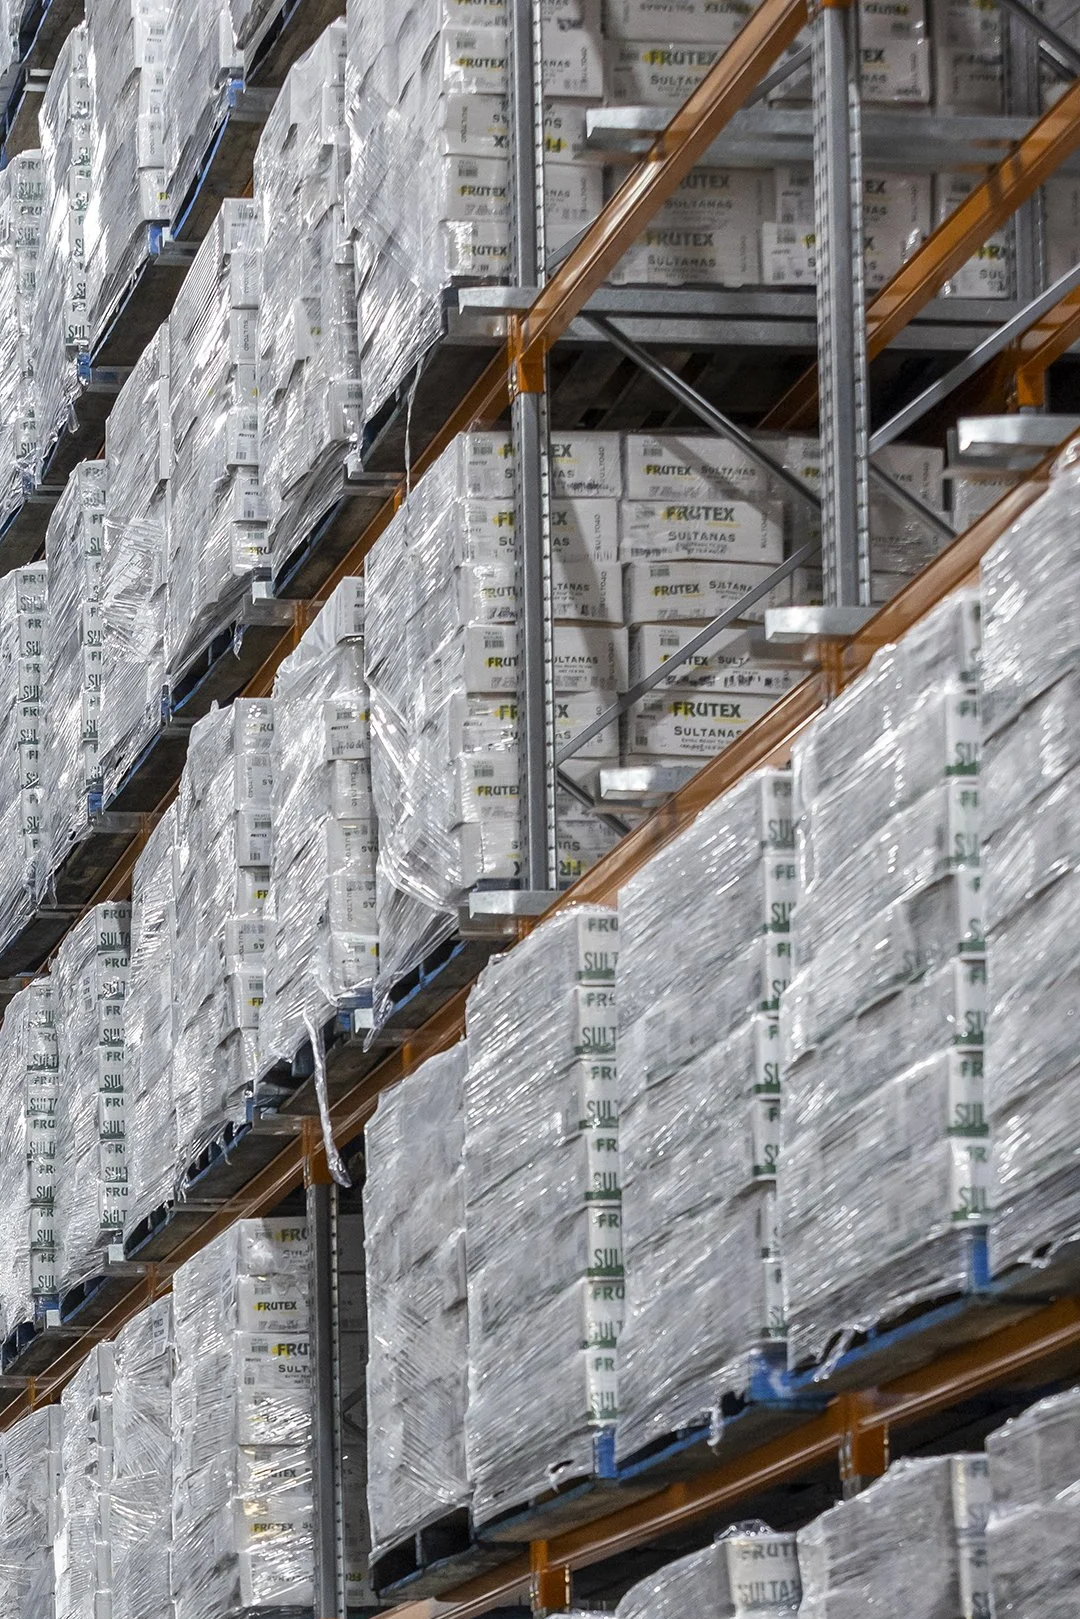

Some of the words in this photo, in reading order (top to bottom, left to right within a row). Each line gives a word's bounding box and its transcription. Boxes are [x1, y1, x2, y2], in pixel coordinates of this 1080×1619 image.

[458, 57, 505, 70] FRUTEX
[19, 182, 42, 195] SULT
[460, 185, 507, 199] FRUTEX
[20, 206, 42, 216] FRU
[646, 231, 714, 247] FRUTEX
[647, 255, 717, 268] SULTANAS
[68, 325, 91, 338] SULT
[645, 464, 693, 476] FRUTEX
[664, 505, 736, 522] FRUTEX
[668, 531, 736, 543] SULTANAS
[653, 583, 700, 597] FRUTEX
[488, 656, 517, 668] FRUT
[672, 701, 742, 719] FRUTEX
[103, 909, 132, 919] FRUT
[588, 917, 618, 933] FRU
[100, 932, 131, 946] SULTA
[105, 958, 128, 968] FRU
[584, 952, 619, 971] SULT
[582, 1027, 617, 1046] SULT
[33, 1054, 58, 1067] SULT
[33, 1119, 55, 1129] FRU
[29, 1141, 56, 1154] SULT
[105, 1187, 128, 1197] FRU
[103, 1210, 128, 1224] SULT
[281, 1228, 307, 1242] FRU
[592, 1287, 625, 1301] FRU
[257, 1301, 298, 1311] FRUTEX
[277, 1343, 310, 1357] FRU
[278, 1364, 308, 1373] SULT
[741, 1543, 797, 1560] FRUT
[739, 1580, 798, 1603] SULTA
